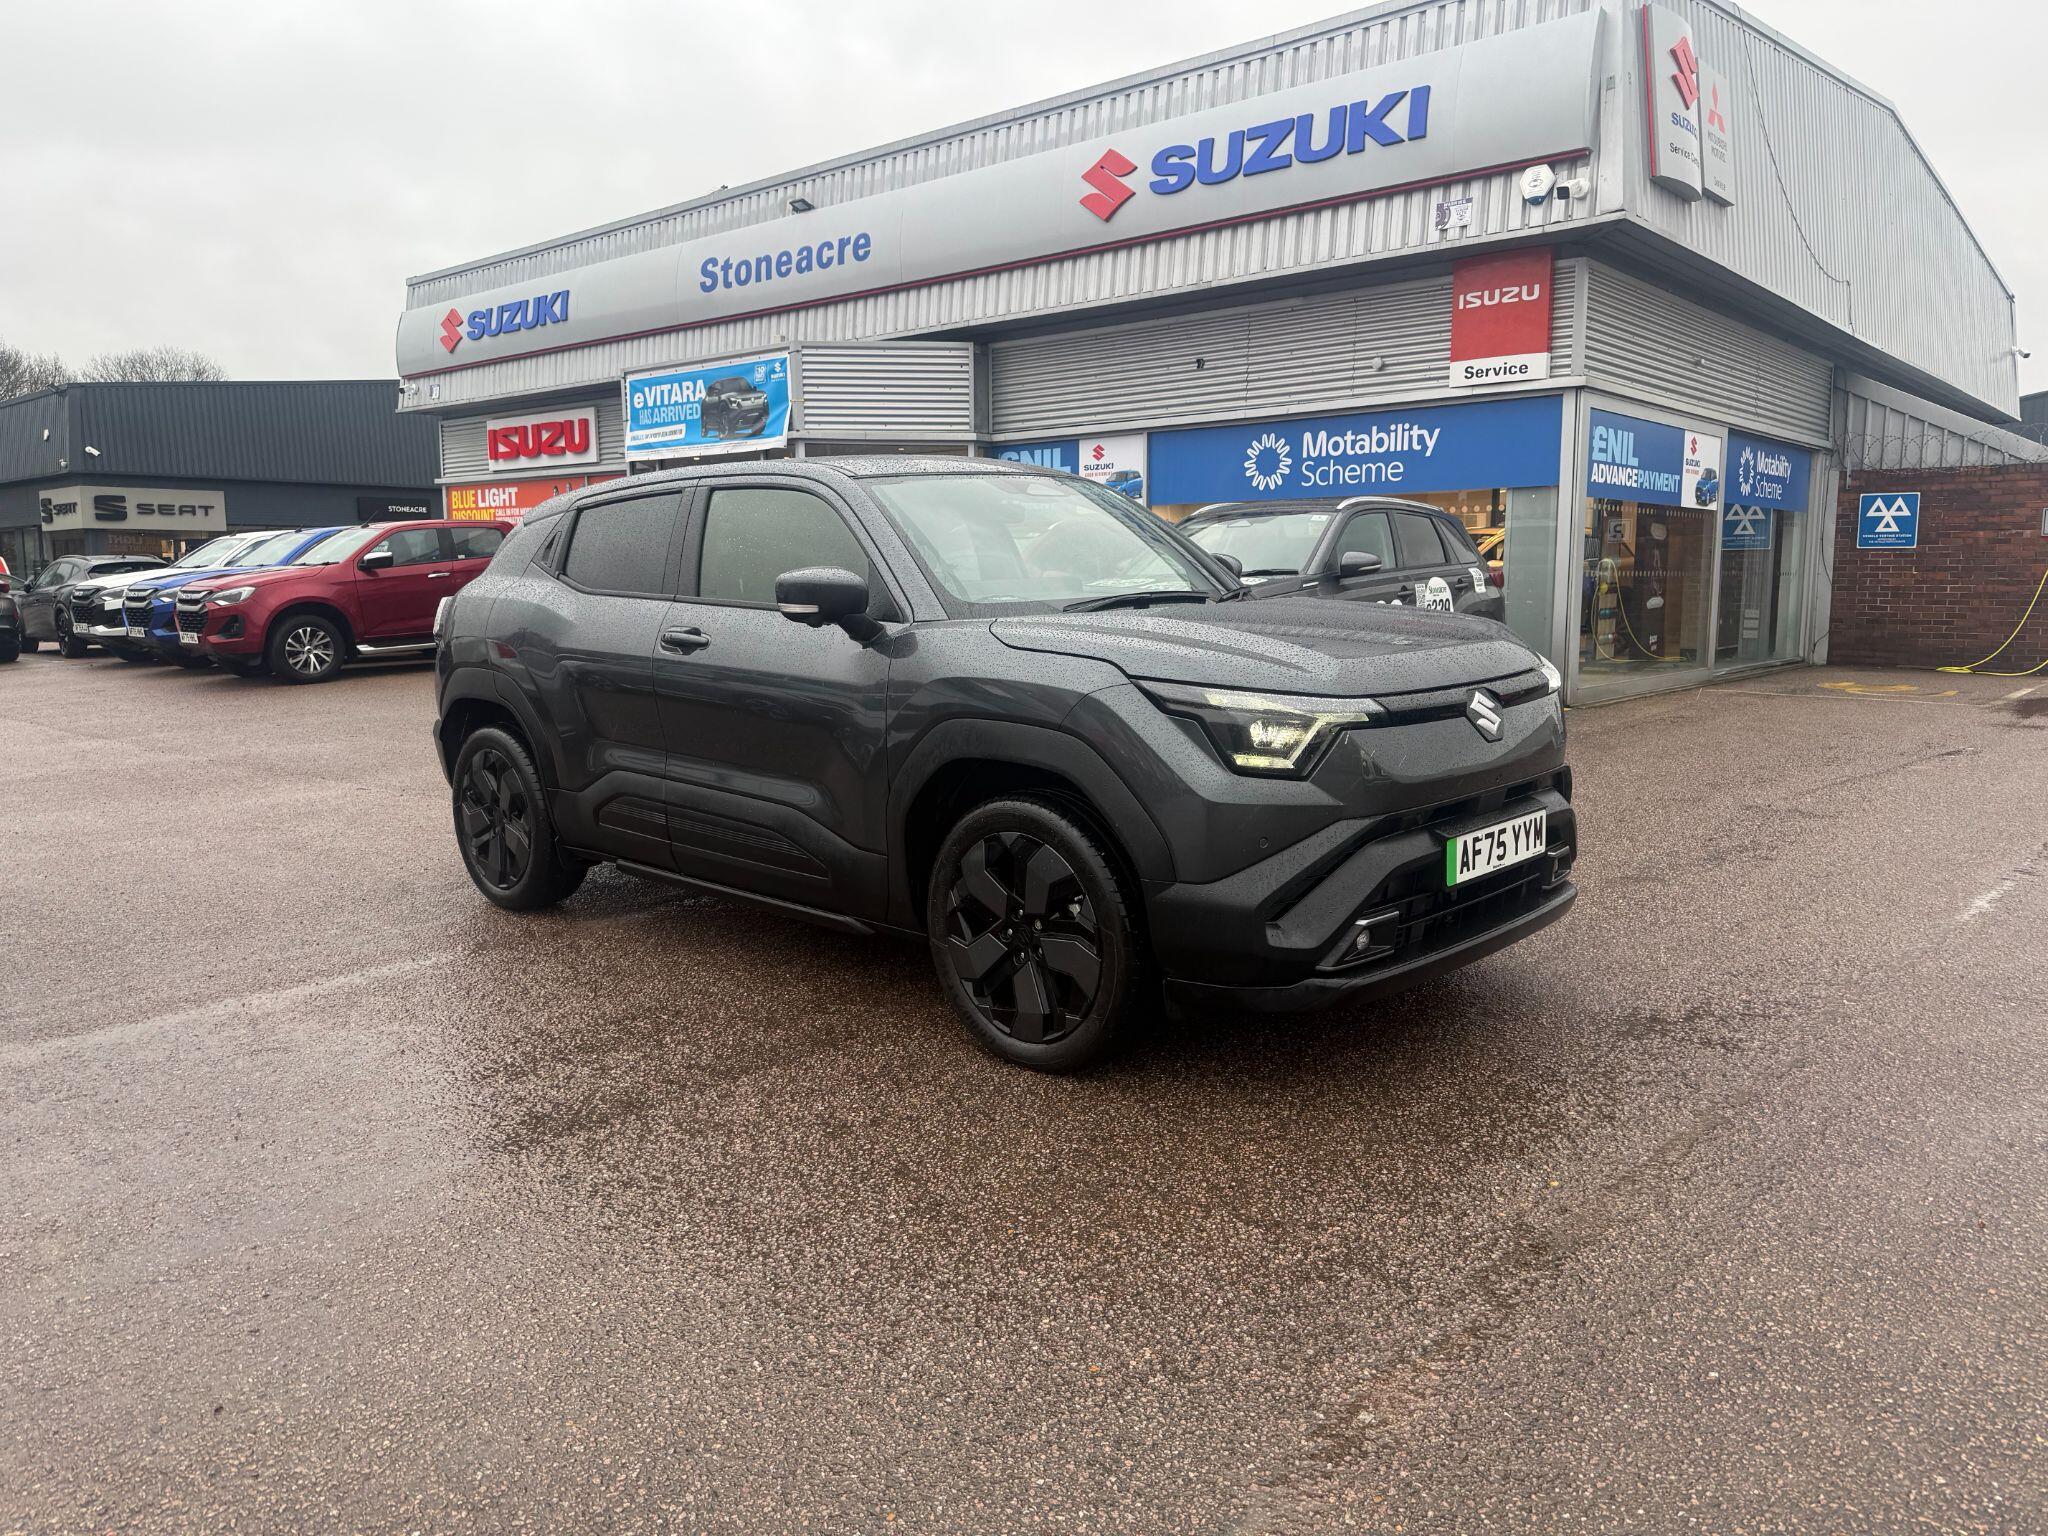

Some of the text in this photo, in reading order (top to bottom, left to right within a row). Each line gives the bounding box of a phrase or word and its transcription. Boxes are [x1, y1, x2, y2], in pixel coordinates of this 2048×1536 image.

[1149, 84, 1431, 195] SUZUKI
[1669, 142, 1691, 160] Service
[700, 231, 872, 293] Stoneacre
[1458, 283, 1540, 310] ISUZU
[466, 290, 570, 340] SUZUKI
[1463, 362, 1529, 380] Service
[633, 379, 707, 409] eVITARA
[639, 403, 700, 425] HAS ARRIVED
[487, 417, 590, 460] ISUZU
[1302, 423, 1441, 458] Motability
[1591, 425, 1639, 467] £NIL
[1083, 463, 1114, 471] SUZUKI
[1301, 459, 1405, 487] Scheme
[1756, 450, 1792, 484] Motability
[451, 486, 518, 509] BLUE LIGHT
[1755, 475, 1783, 500] Scheme
[54, 501, 78, 515] SEAT
[136, 503, 215, 517] SEAT
[388, 505, 427, 513] STONEACRE
[452, 508, 495, 520] DISCOUNT
[1459, 815, 1543, 875] AF75 YYM
